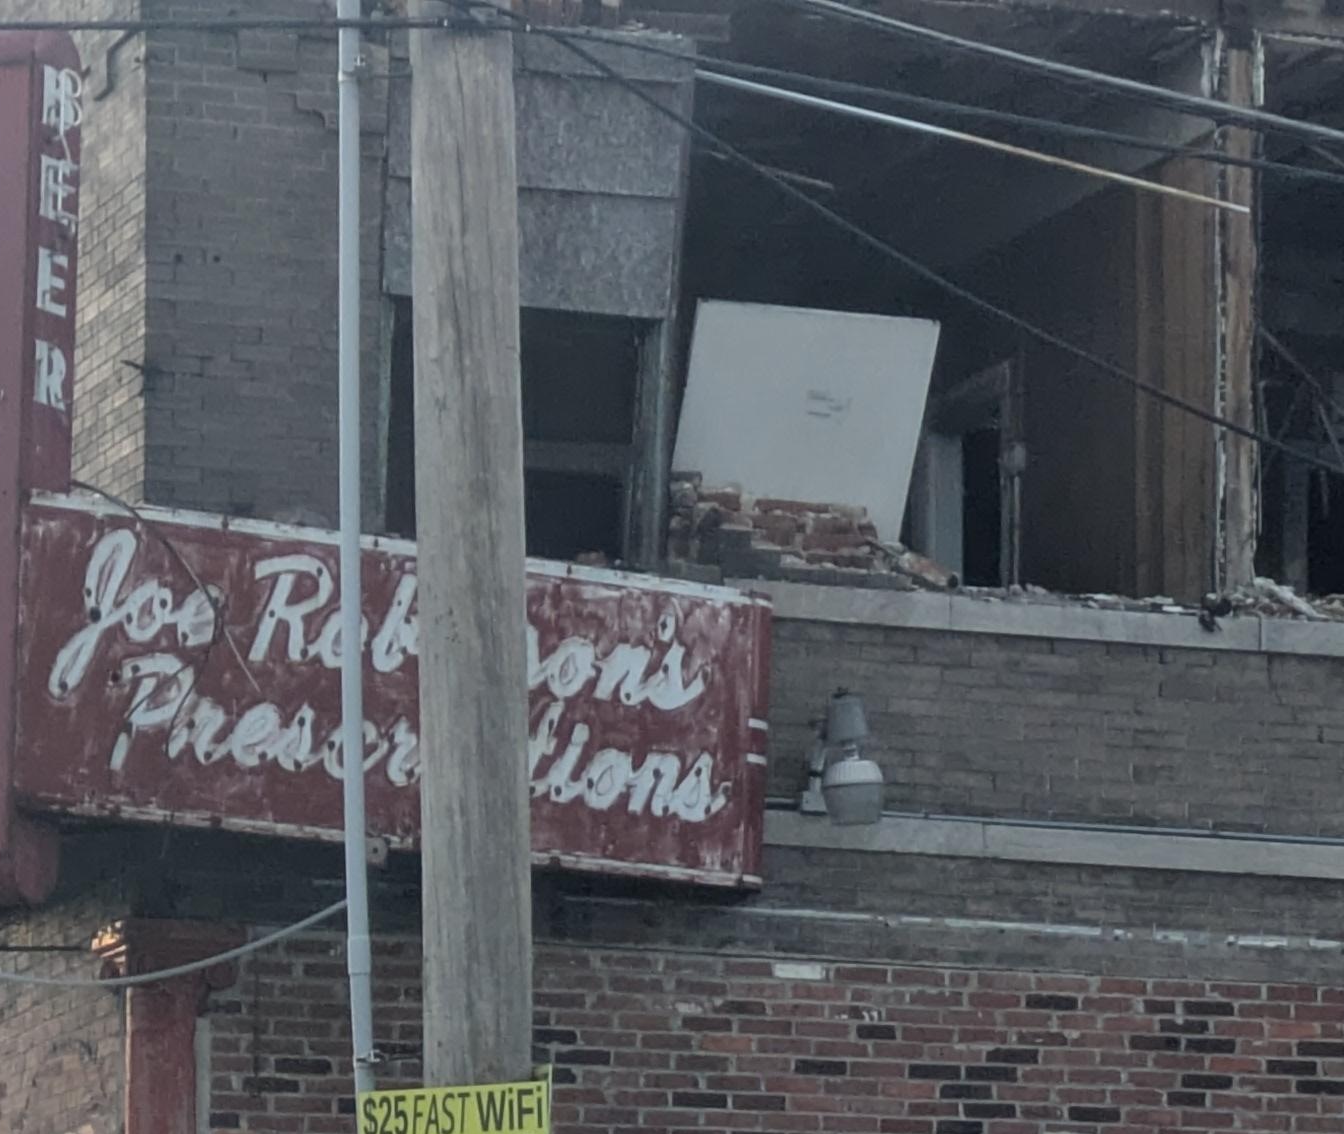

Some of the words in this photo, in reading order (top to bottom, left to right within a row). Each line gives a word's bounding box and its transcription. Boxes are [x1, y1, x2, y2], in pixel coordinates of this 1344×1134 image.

[33, 64, 82, 412] BEER
[48, 528, 224, 702] Joe
[109, 652, 733, 822] Prescrtions
[476, 1084, 544, 1132] WiFi
